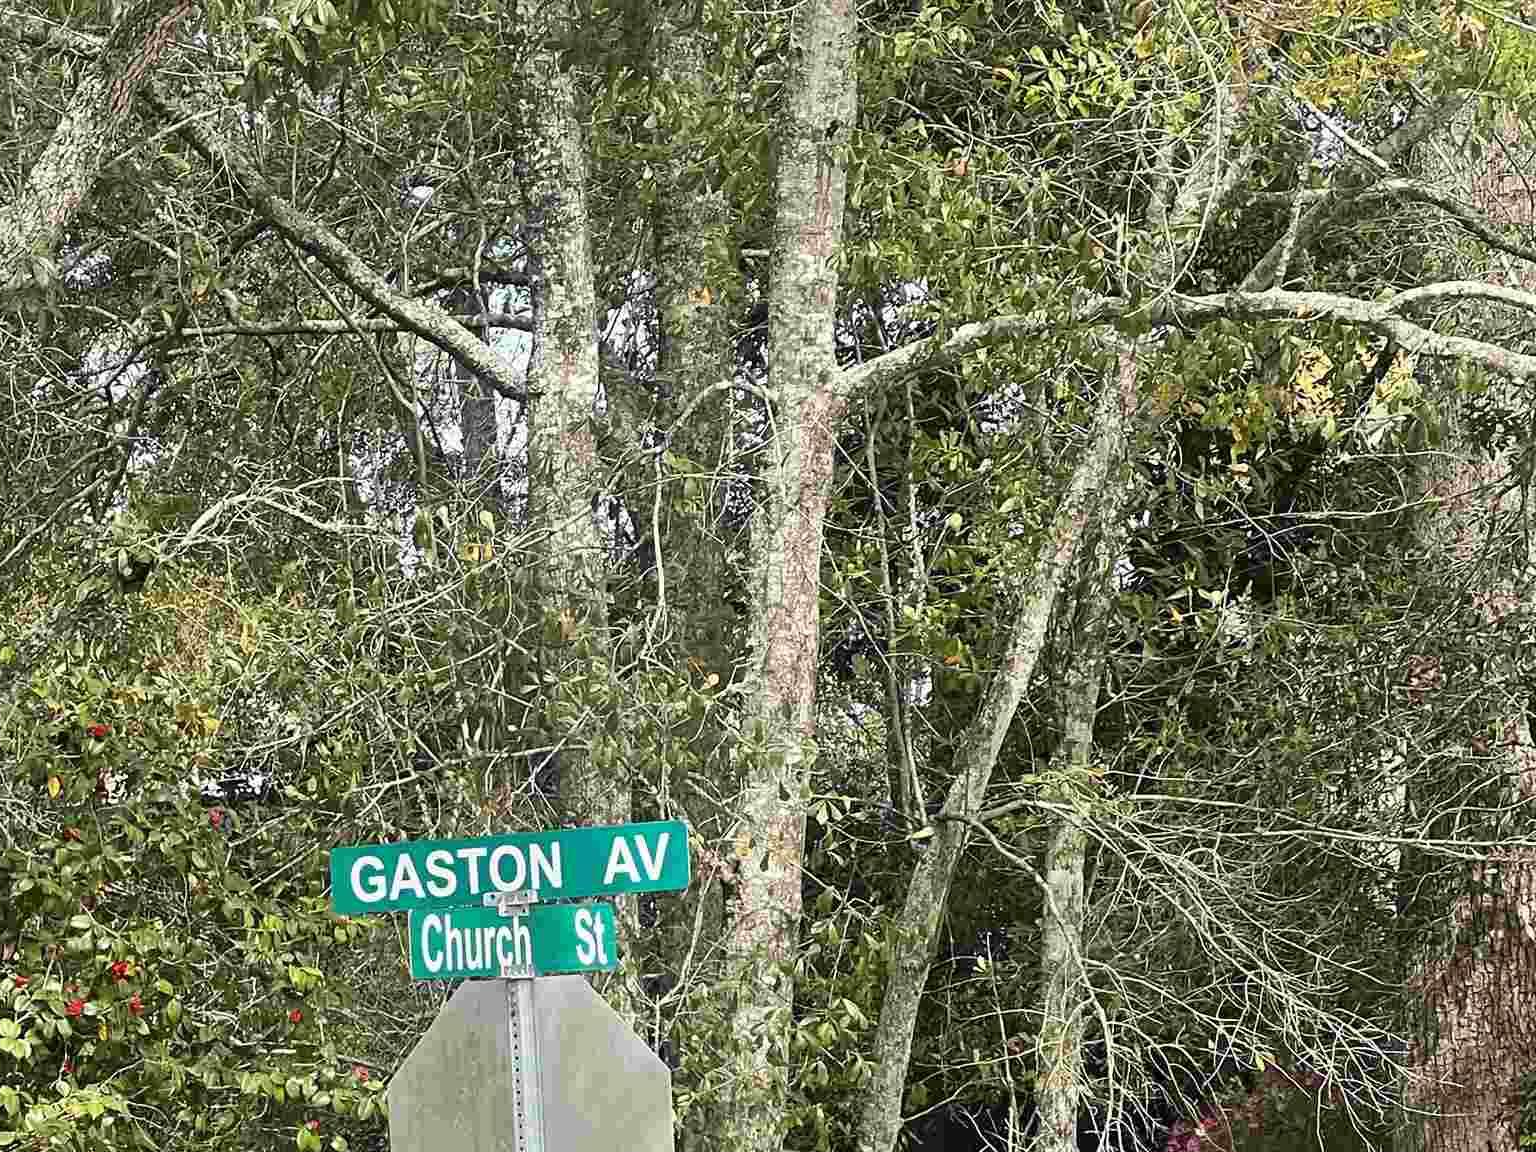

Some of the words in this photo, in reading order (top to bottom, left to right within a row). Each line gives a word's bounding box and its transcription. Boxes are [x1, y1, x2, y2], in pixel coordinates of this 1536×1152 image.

[350, 841, 563, 903] GASTON
[603, 832, 670, 885] AV
[421, 911, 533, 974] Church
[575, 908, 608, 967] St
